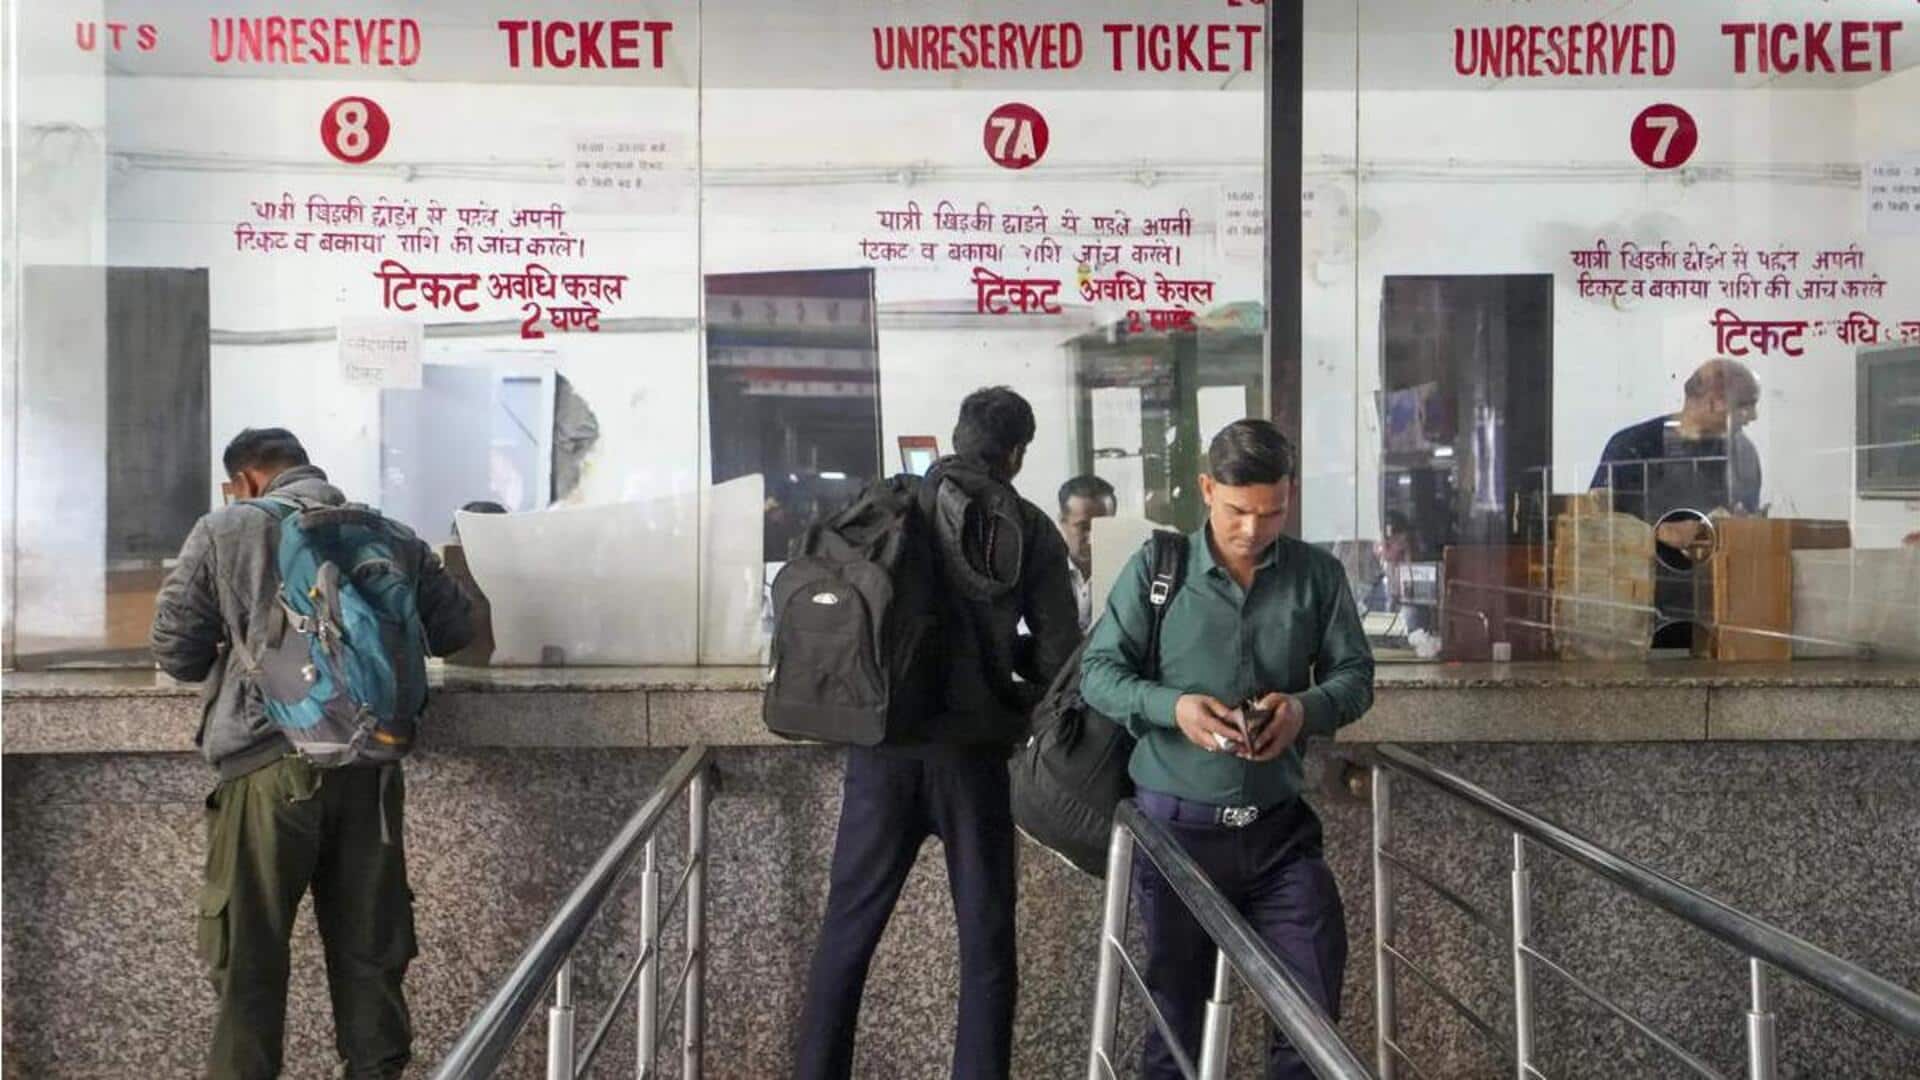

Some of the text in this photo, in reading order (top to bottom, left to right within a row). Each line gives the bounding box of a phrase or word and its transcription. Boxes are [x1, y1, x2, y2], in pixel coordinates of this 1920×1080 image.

[76, 17, 673, 69] UTS UNRESEVED TICKET
[874, 22, 1263, 73] UNRESERVED TICKET
[1455, 20, 1903, 77] UNRESERVED TICKET
[335, 102, 370, 157] 8
[991, 117, 1037, 159] 7A
[1645, 116, 1679, 162] 7
[509, 203, 565, 229] अपनी
[876, 201, 923, 231] यात्री
[1143, 208, 1193, 237] अपनी
[294, 232, 314, 251] व
[319, 233, 385, 253] बकाया
[920, 243, 939, 260] व
[949, 242, 1004, 261] बकाया
[1570, 239, 1611, 270] यात्री
[1812, 243, 1864, 270] अपनी
[374, 260, 481, 312] टिकट
[488, 264, 558, 300] अवधि
[972, 266, 1216, 315] टिकट अवधि केवल
[1577, 271, 1628, 298] टिकट
[1632, 279, 1646, 297] व
[1650, 279, 1711, 298] बकाया
[1718, 272, 1761, 298] राशि
[1764, 273, 1792, 298] की
[521, 301, 600, 339] 2 घण्टे
[1126, 309, 1144, 333] 2
[1710, 308, 1809, 357] टिकट
